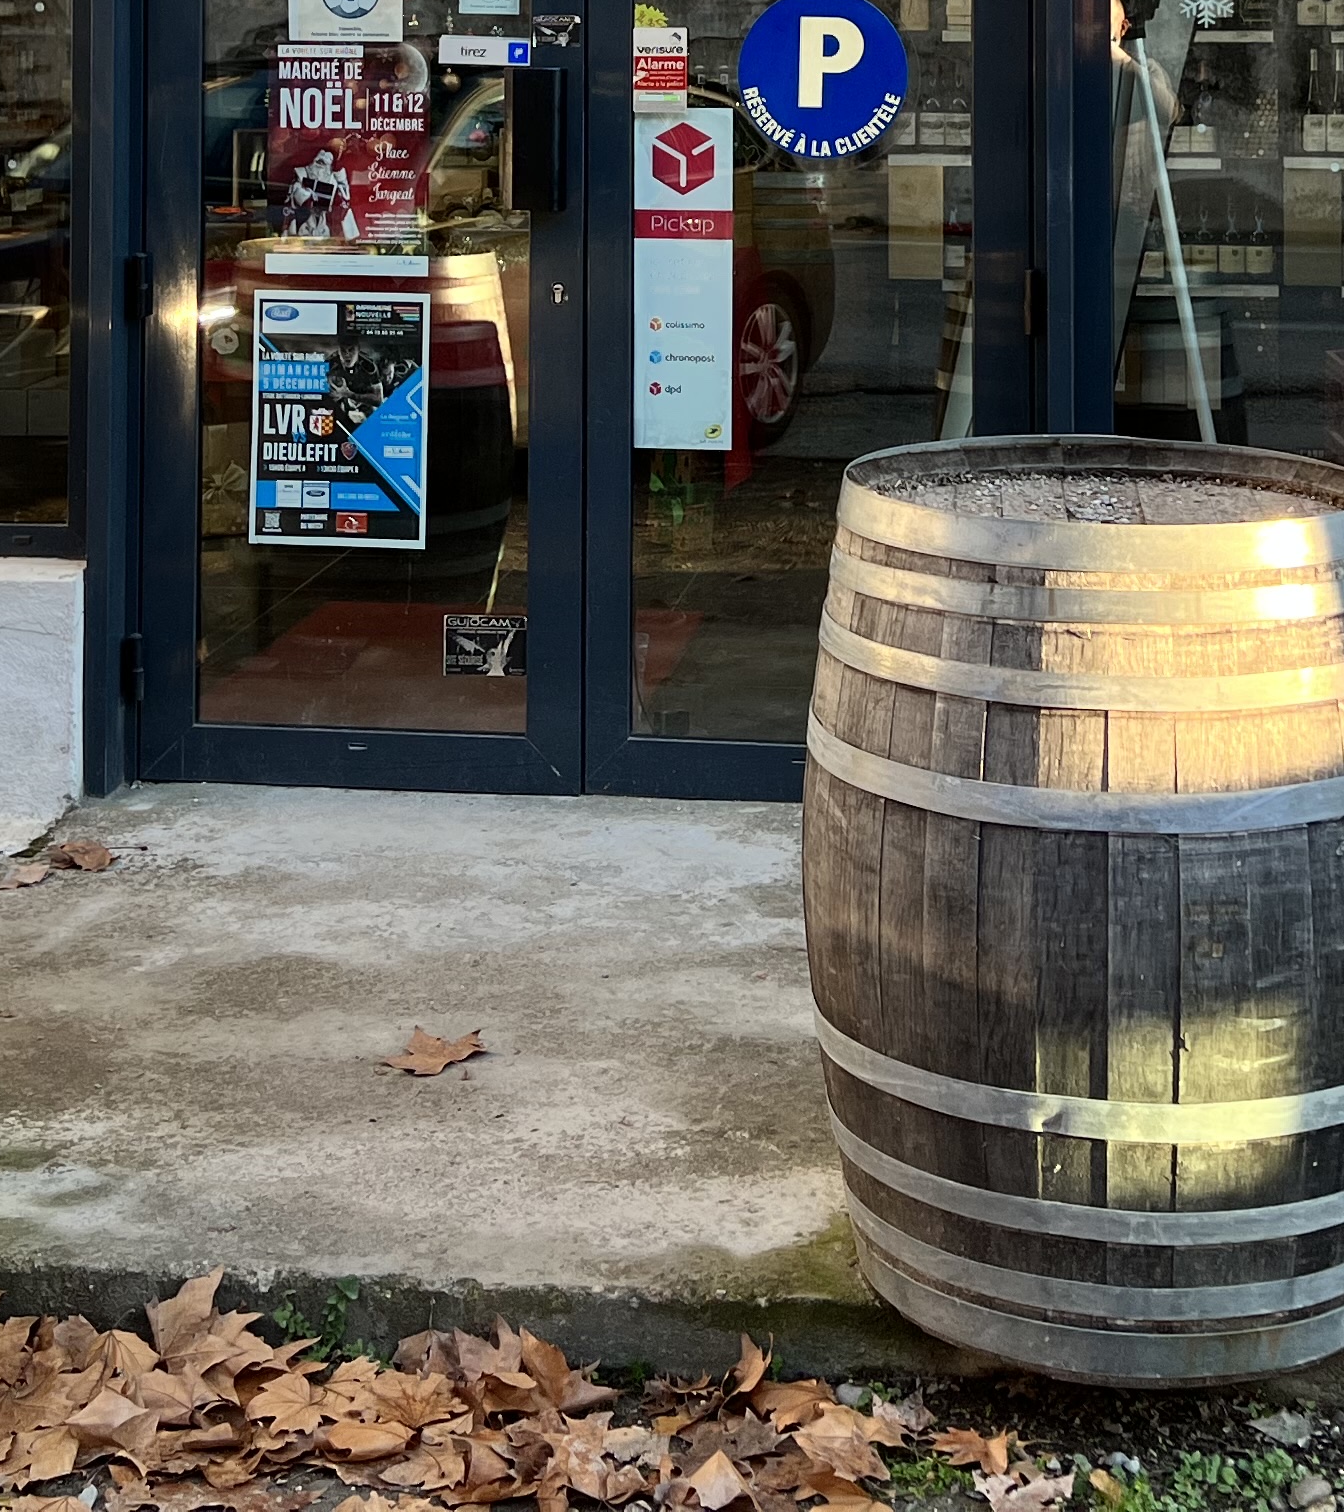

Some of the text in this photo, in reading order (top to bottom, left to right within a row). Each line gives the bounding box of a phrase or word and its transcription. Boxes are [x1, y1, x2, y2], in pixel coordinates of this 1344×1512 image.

[460, 46, 487, 58] tirez
[636, 45, 684, 54] verisure
[278, 58, 363, 80] MARCHÉ DE
[637, 57, 685, 70] Alarme
[797, 15, 865, 108] P
[279, 81, 363, 130] NOËL
[373, 92, 423, 113] 11 & 12
[370, 116, 424, 131] DÉCEMBRE
[742, 86, 902, 157] RÉSERVÉ À LA CLIENTÈLE
[374, 140, 410, 161] Place
[649, 214, 716, 236] Pickup
[665, 321, 706, 330] colissimo
[664, 353, 716, 364] chronopost
[263, 363, 326, 377] DIMANCHE
[263, 376, 326, 391] 5 DÉCEMBRE
[664, 384, 682, 395] dpd
[263, 403, 306, 435] LVR
[262, 441, 339, 462] DIEULEFIT
